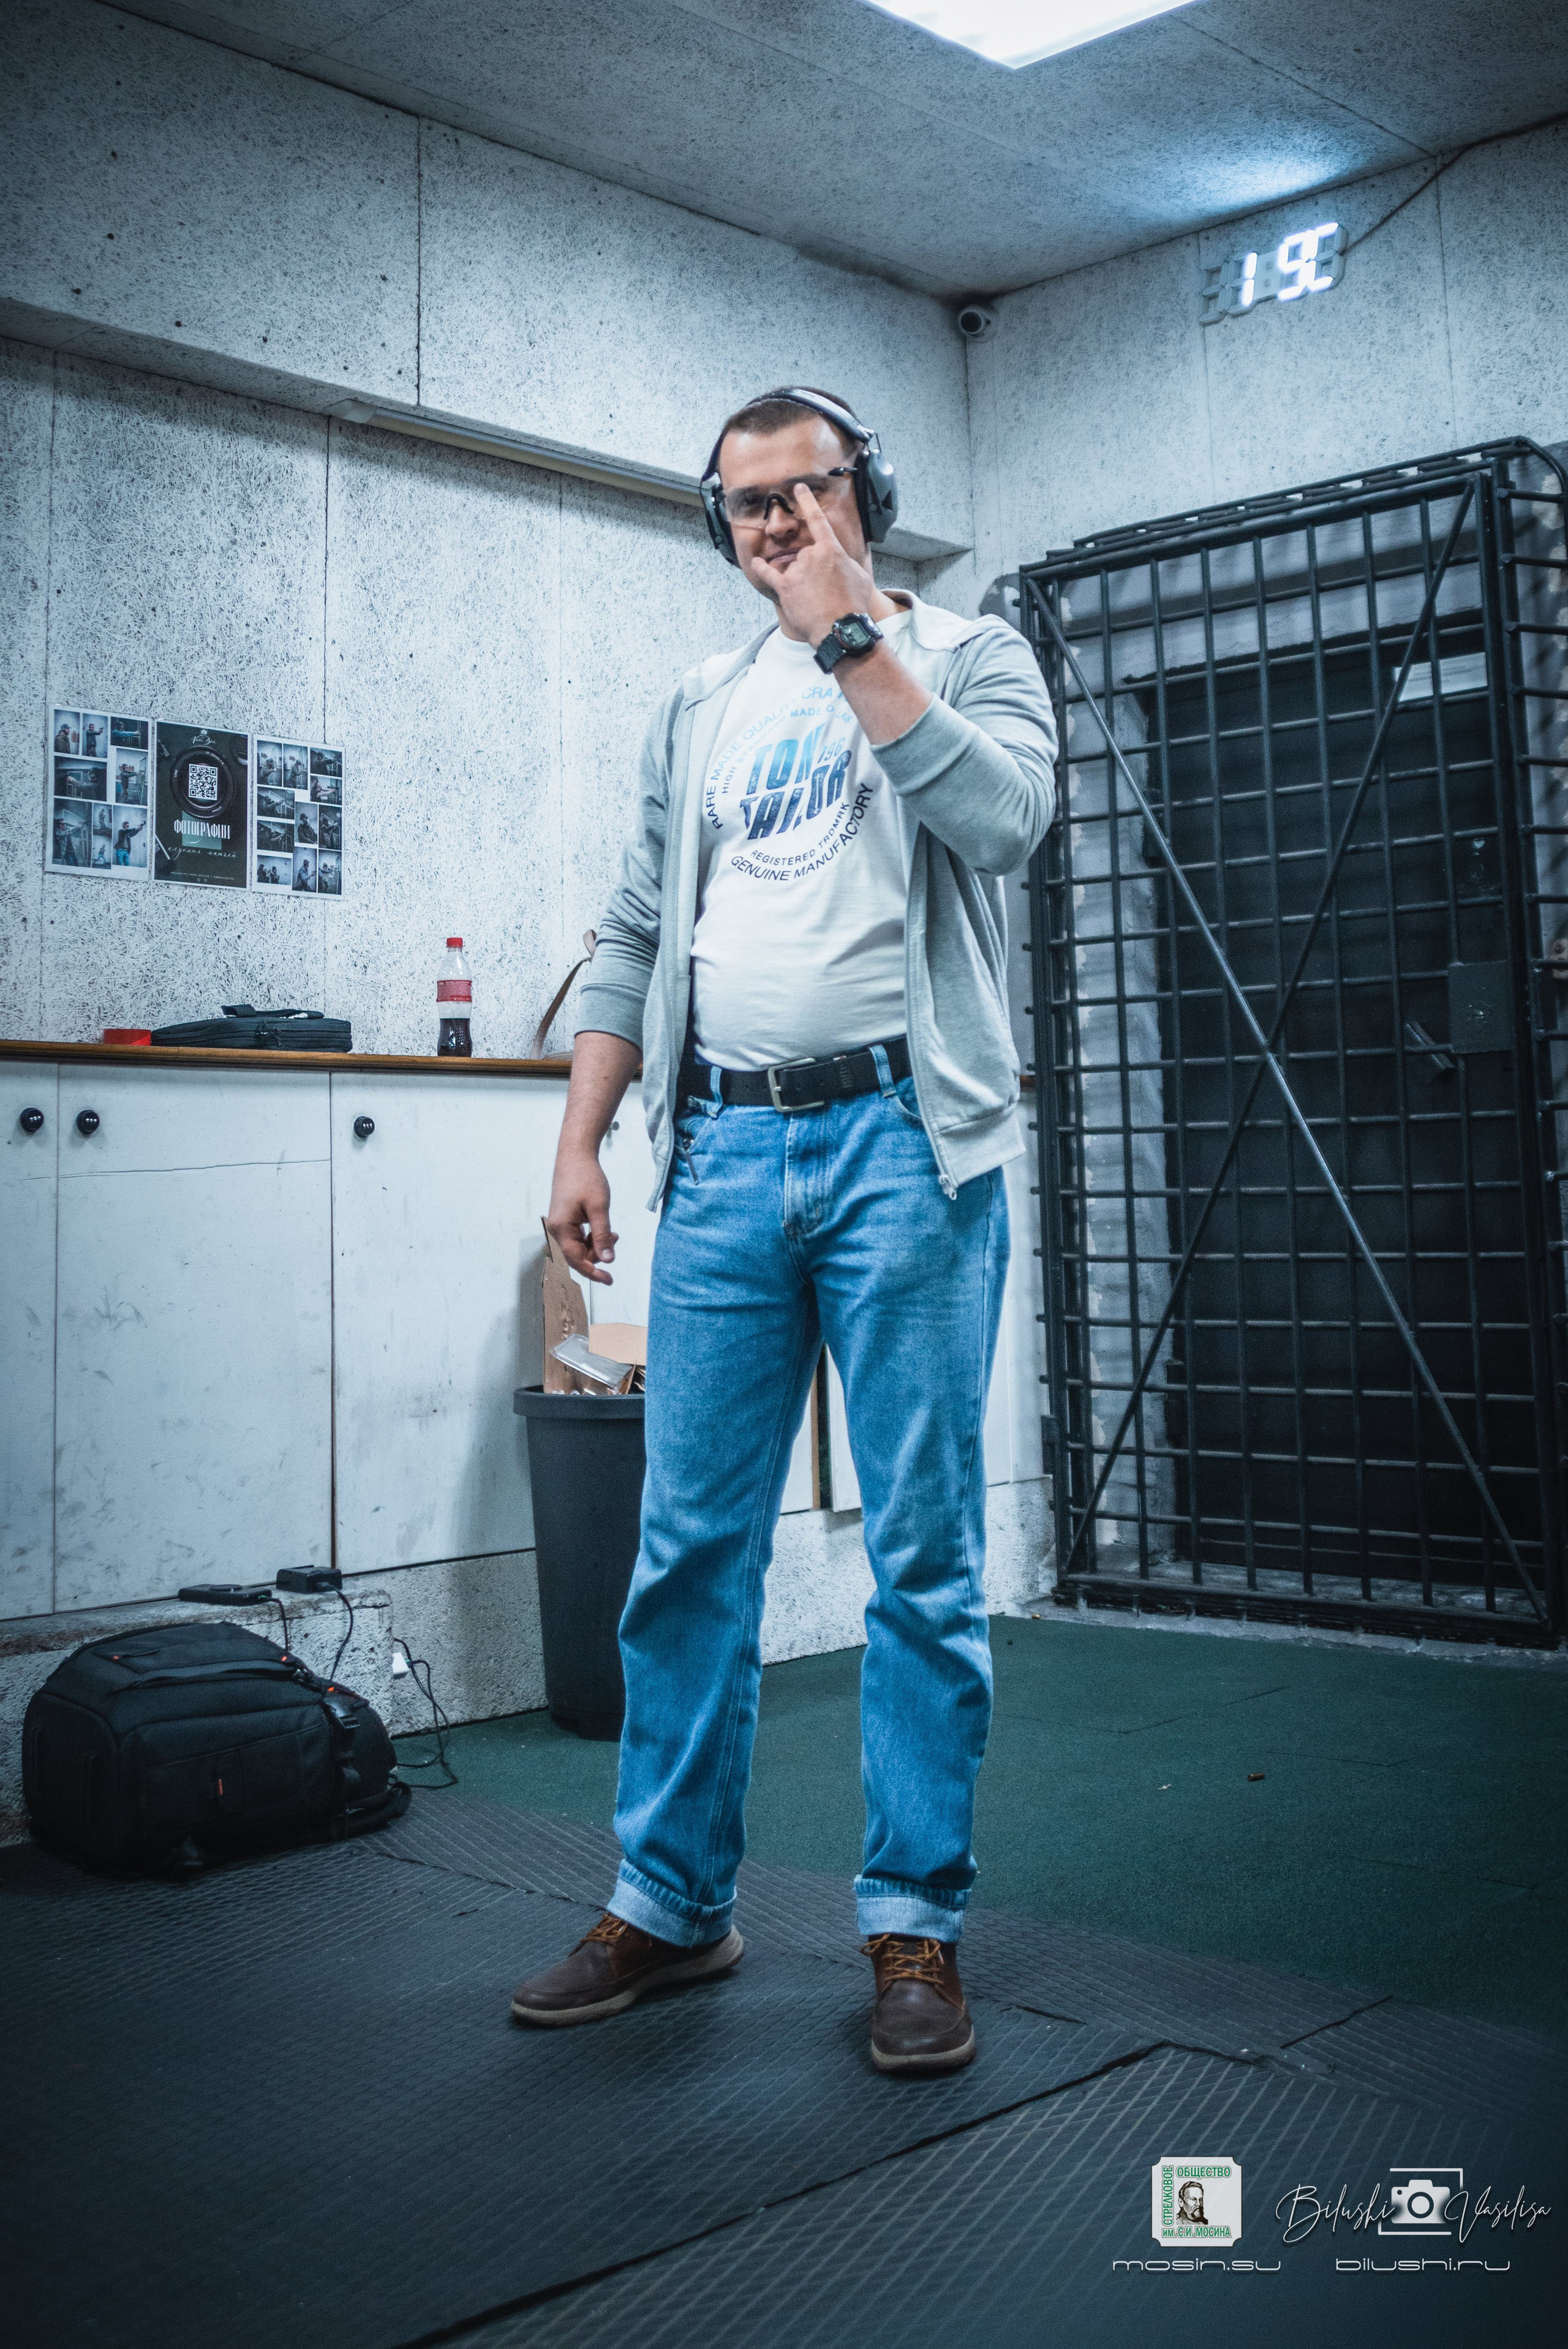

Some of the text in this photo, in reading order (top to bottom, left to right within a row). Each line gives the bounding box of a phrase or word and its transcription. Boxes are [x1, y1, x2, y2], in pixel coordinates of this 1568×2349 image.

[710, 740, 742, 780] MADE
[722, 766, 737, 794] HIGH
[790, 707, 823, 718] MADE
[706, 785, 723, 830] RARE
[174, 820, 230, 839] ФОТОГРАФИИ
[731, 782, 873, 881] GENUINE MANUFACTORY
[750, 849, 816, 866] REGISTERED
